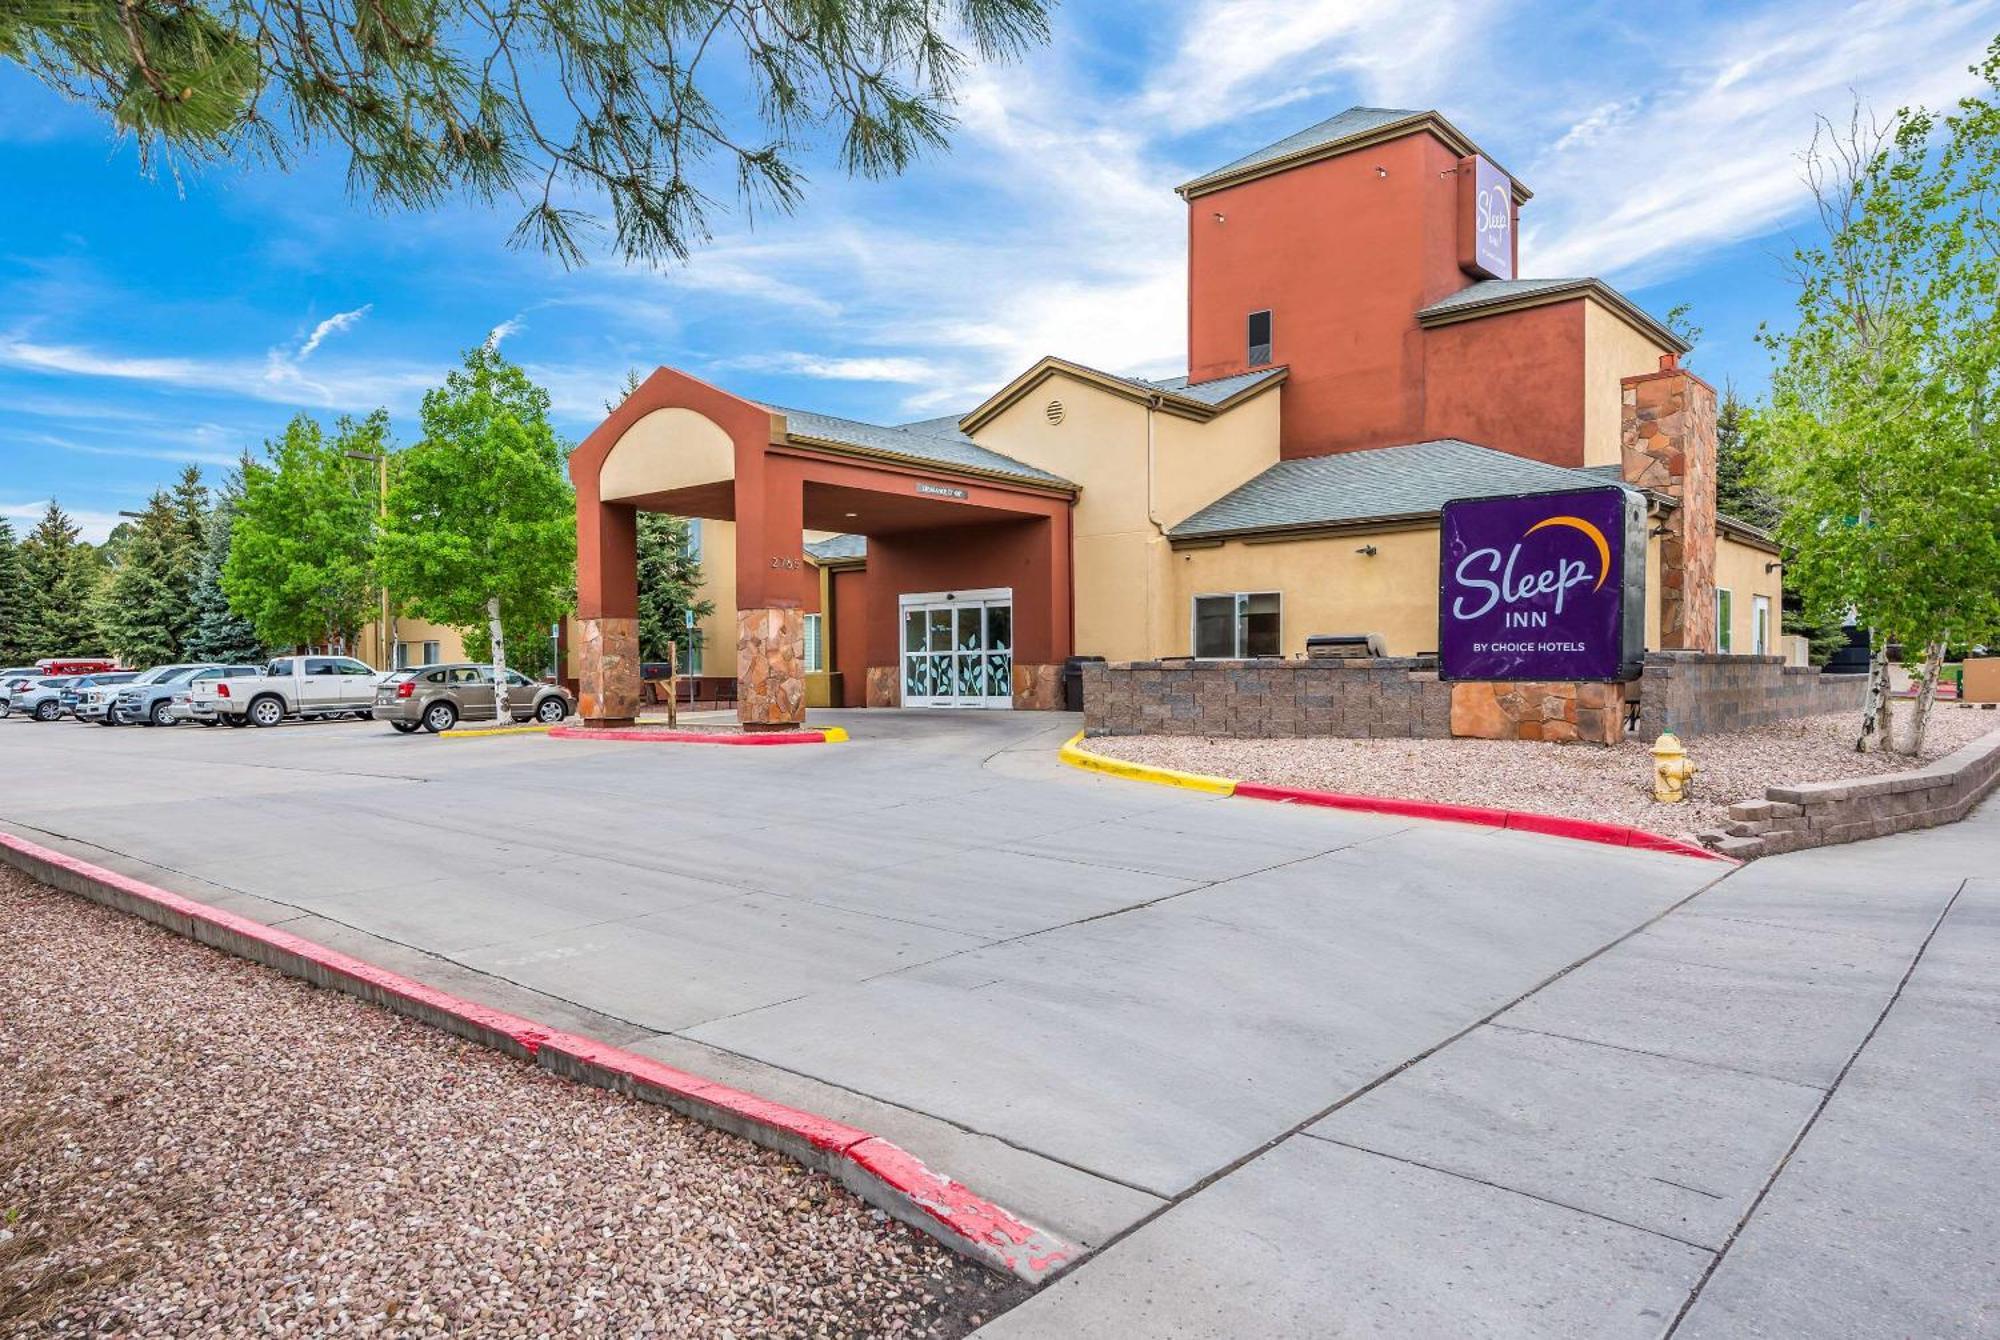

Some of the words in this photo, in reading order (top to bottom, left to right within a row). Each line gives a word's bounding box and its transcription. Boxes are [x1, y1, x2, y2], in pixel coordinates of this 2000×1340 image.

[1478, 190, 1507, 243] Sleep
[1453, 543, 1594, 620] Sleep
[1505, 611, 1547, 628] INN
[1473, 643, 1488, 652] BY
[1491, 642, 1535, 652] CHOICE
[1538, 642, 1585, 652] HOTELS
